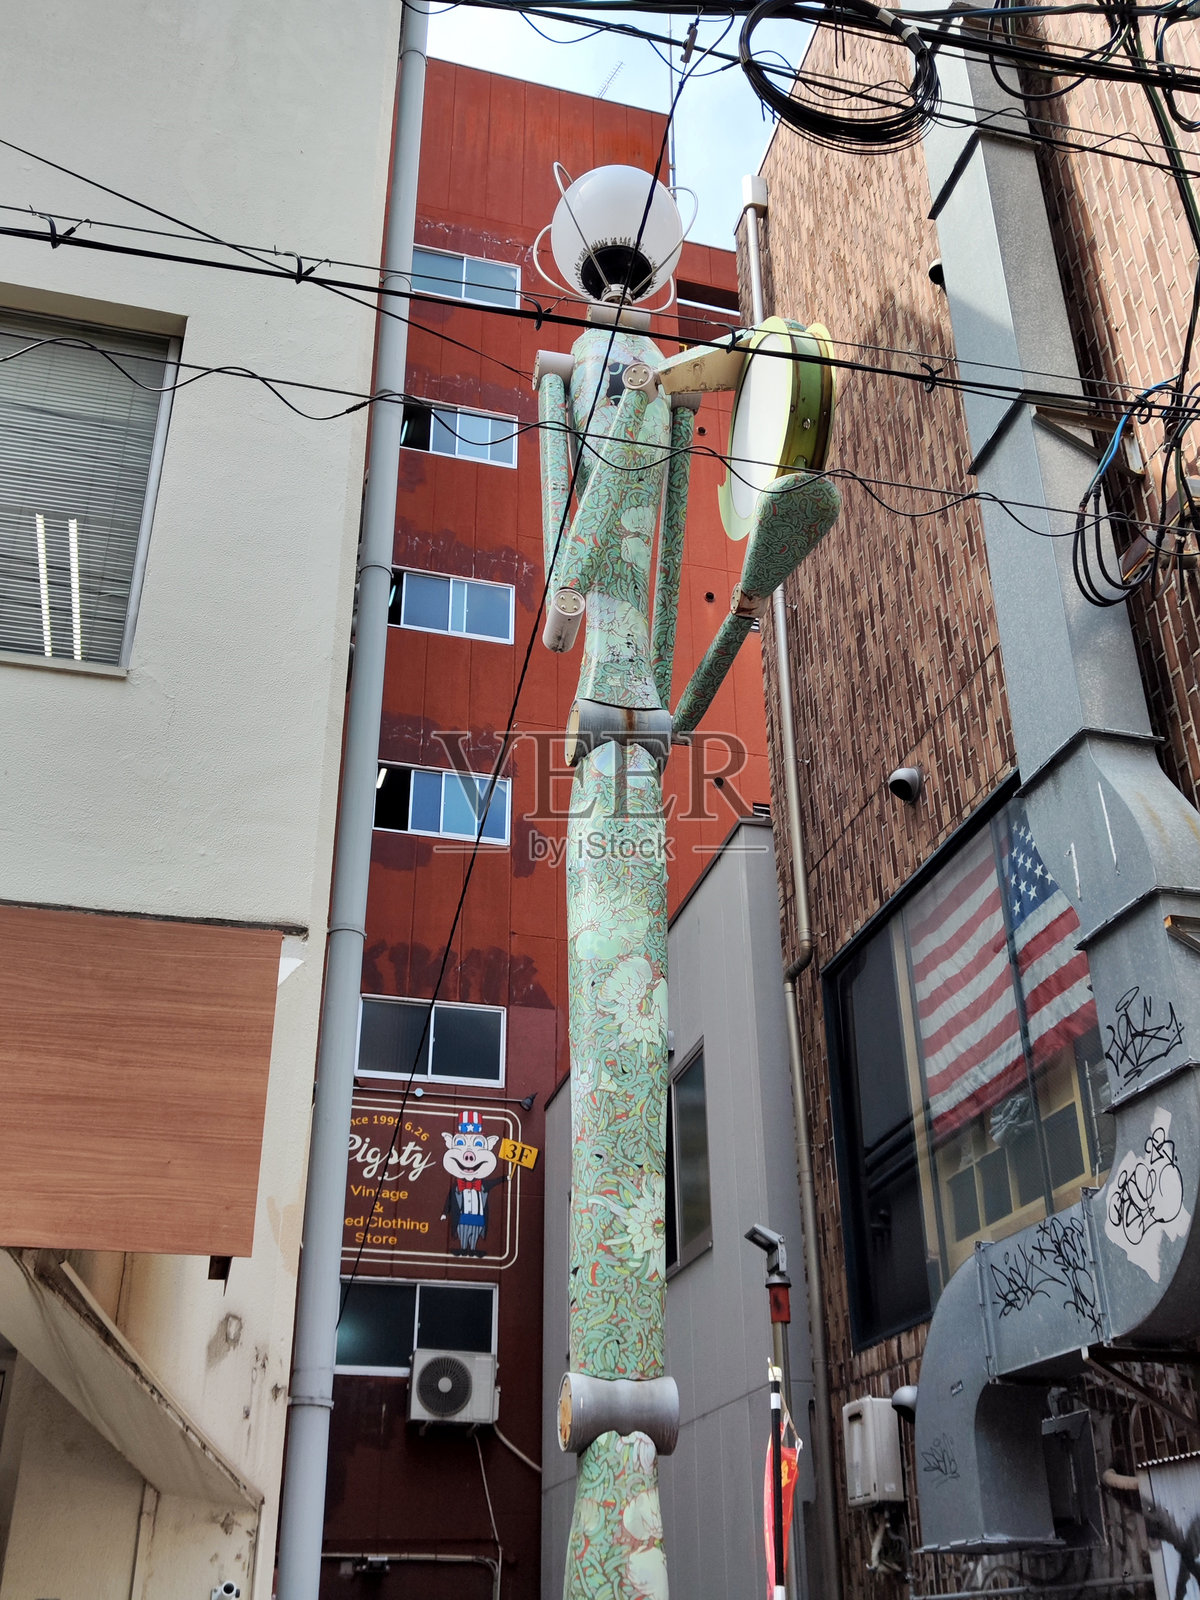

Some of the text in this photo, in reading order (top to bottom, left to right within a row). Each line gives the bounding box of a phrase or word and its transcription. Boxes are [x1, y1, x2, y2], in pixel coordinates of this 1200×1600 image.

[505, 1143, 533, 1164] 3F
[373, 1201, 385, 1213] &
[366, 1216, 429, 1234] Clothing
[355, 1231, 398, 1245] Store
